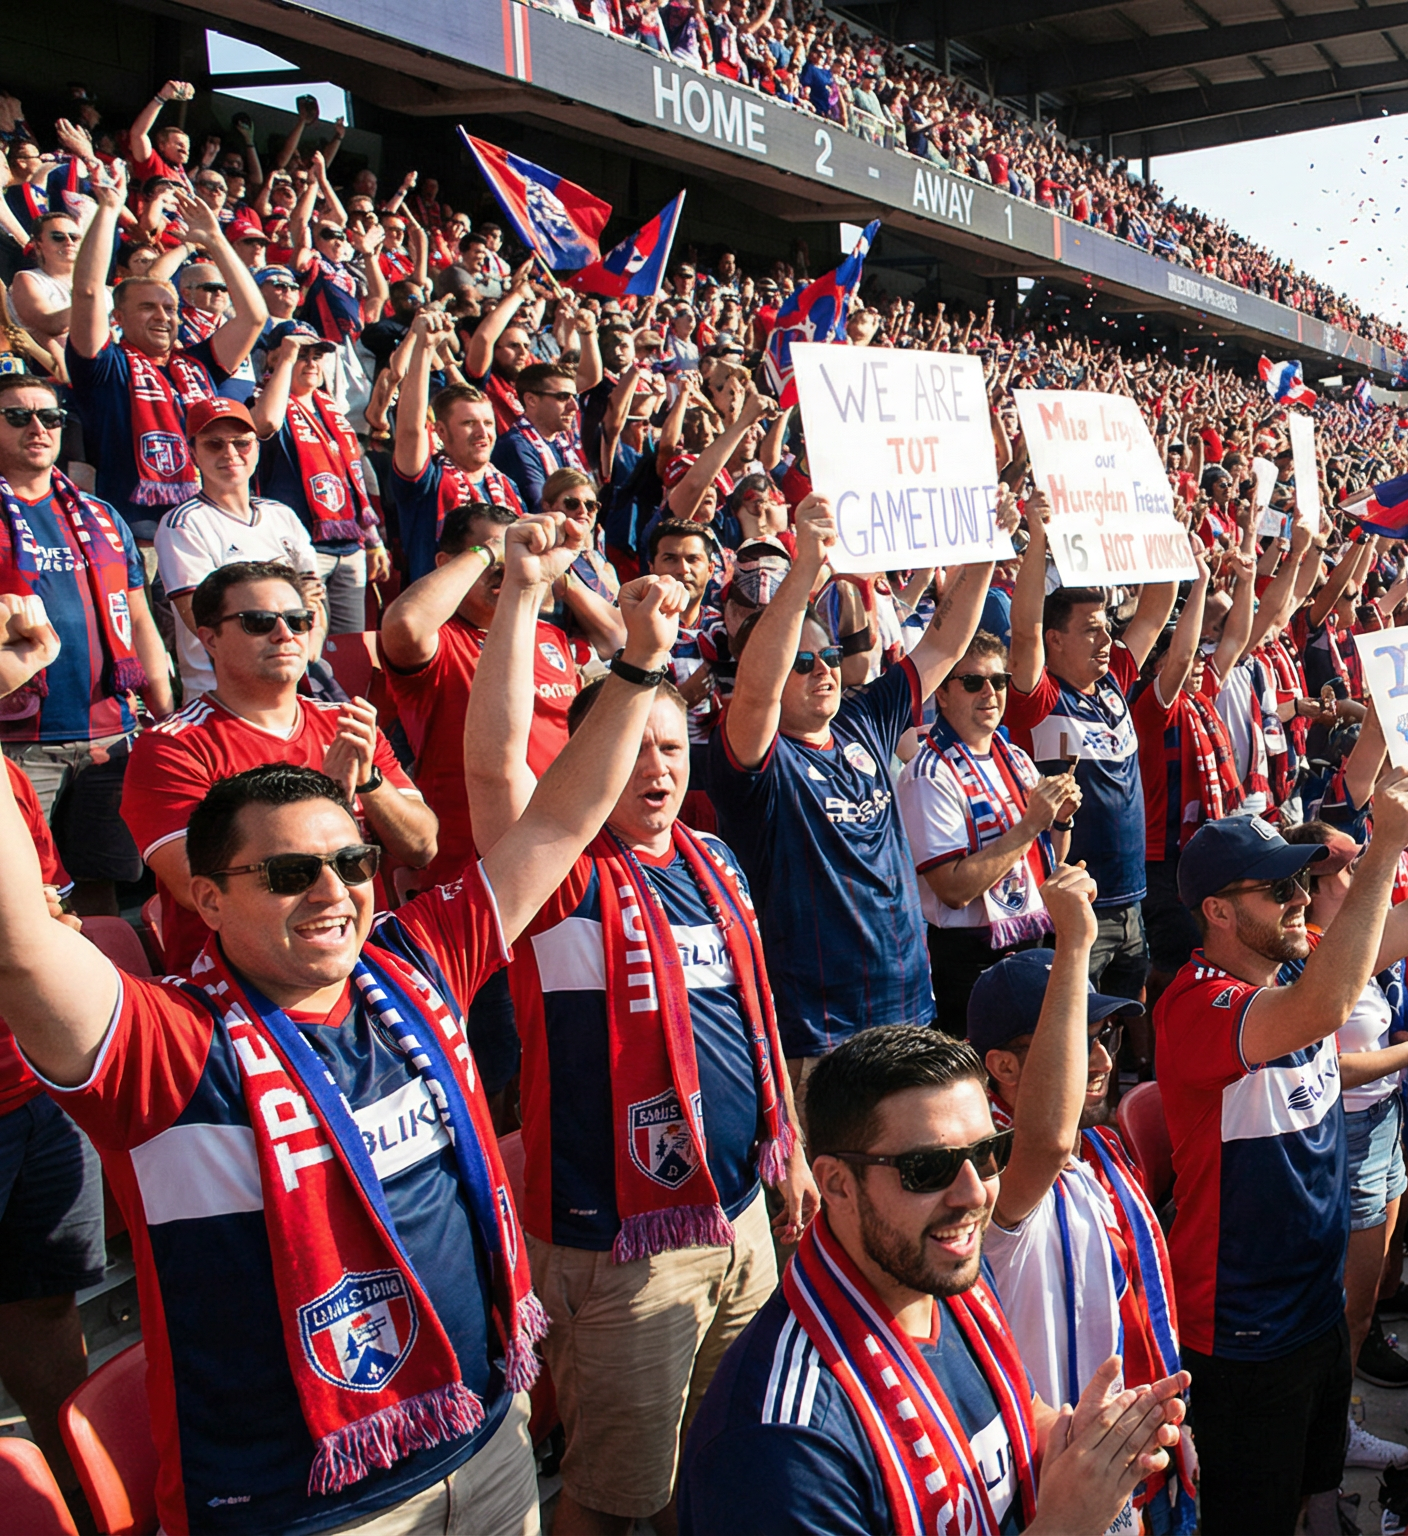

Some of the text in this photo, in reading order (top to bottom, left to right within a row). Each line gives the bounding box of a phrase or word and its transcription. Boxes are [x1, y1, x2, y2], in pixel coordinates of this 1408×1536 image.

[653, 66, 767, 154] HOME
[814, 129, 834, 178] 2
[913, 168, 974, 225] AWAY
[1004, 204, 1014, 240] 1
[819, 361, 970, 423] WE ARE
[1063, 533, 1089, 572] IS
